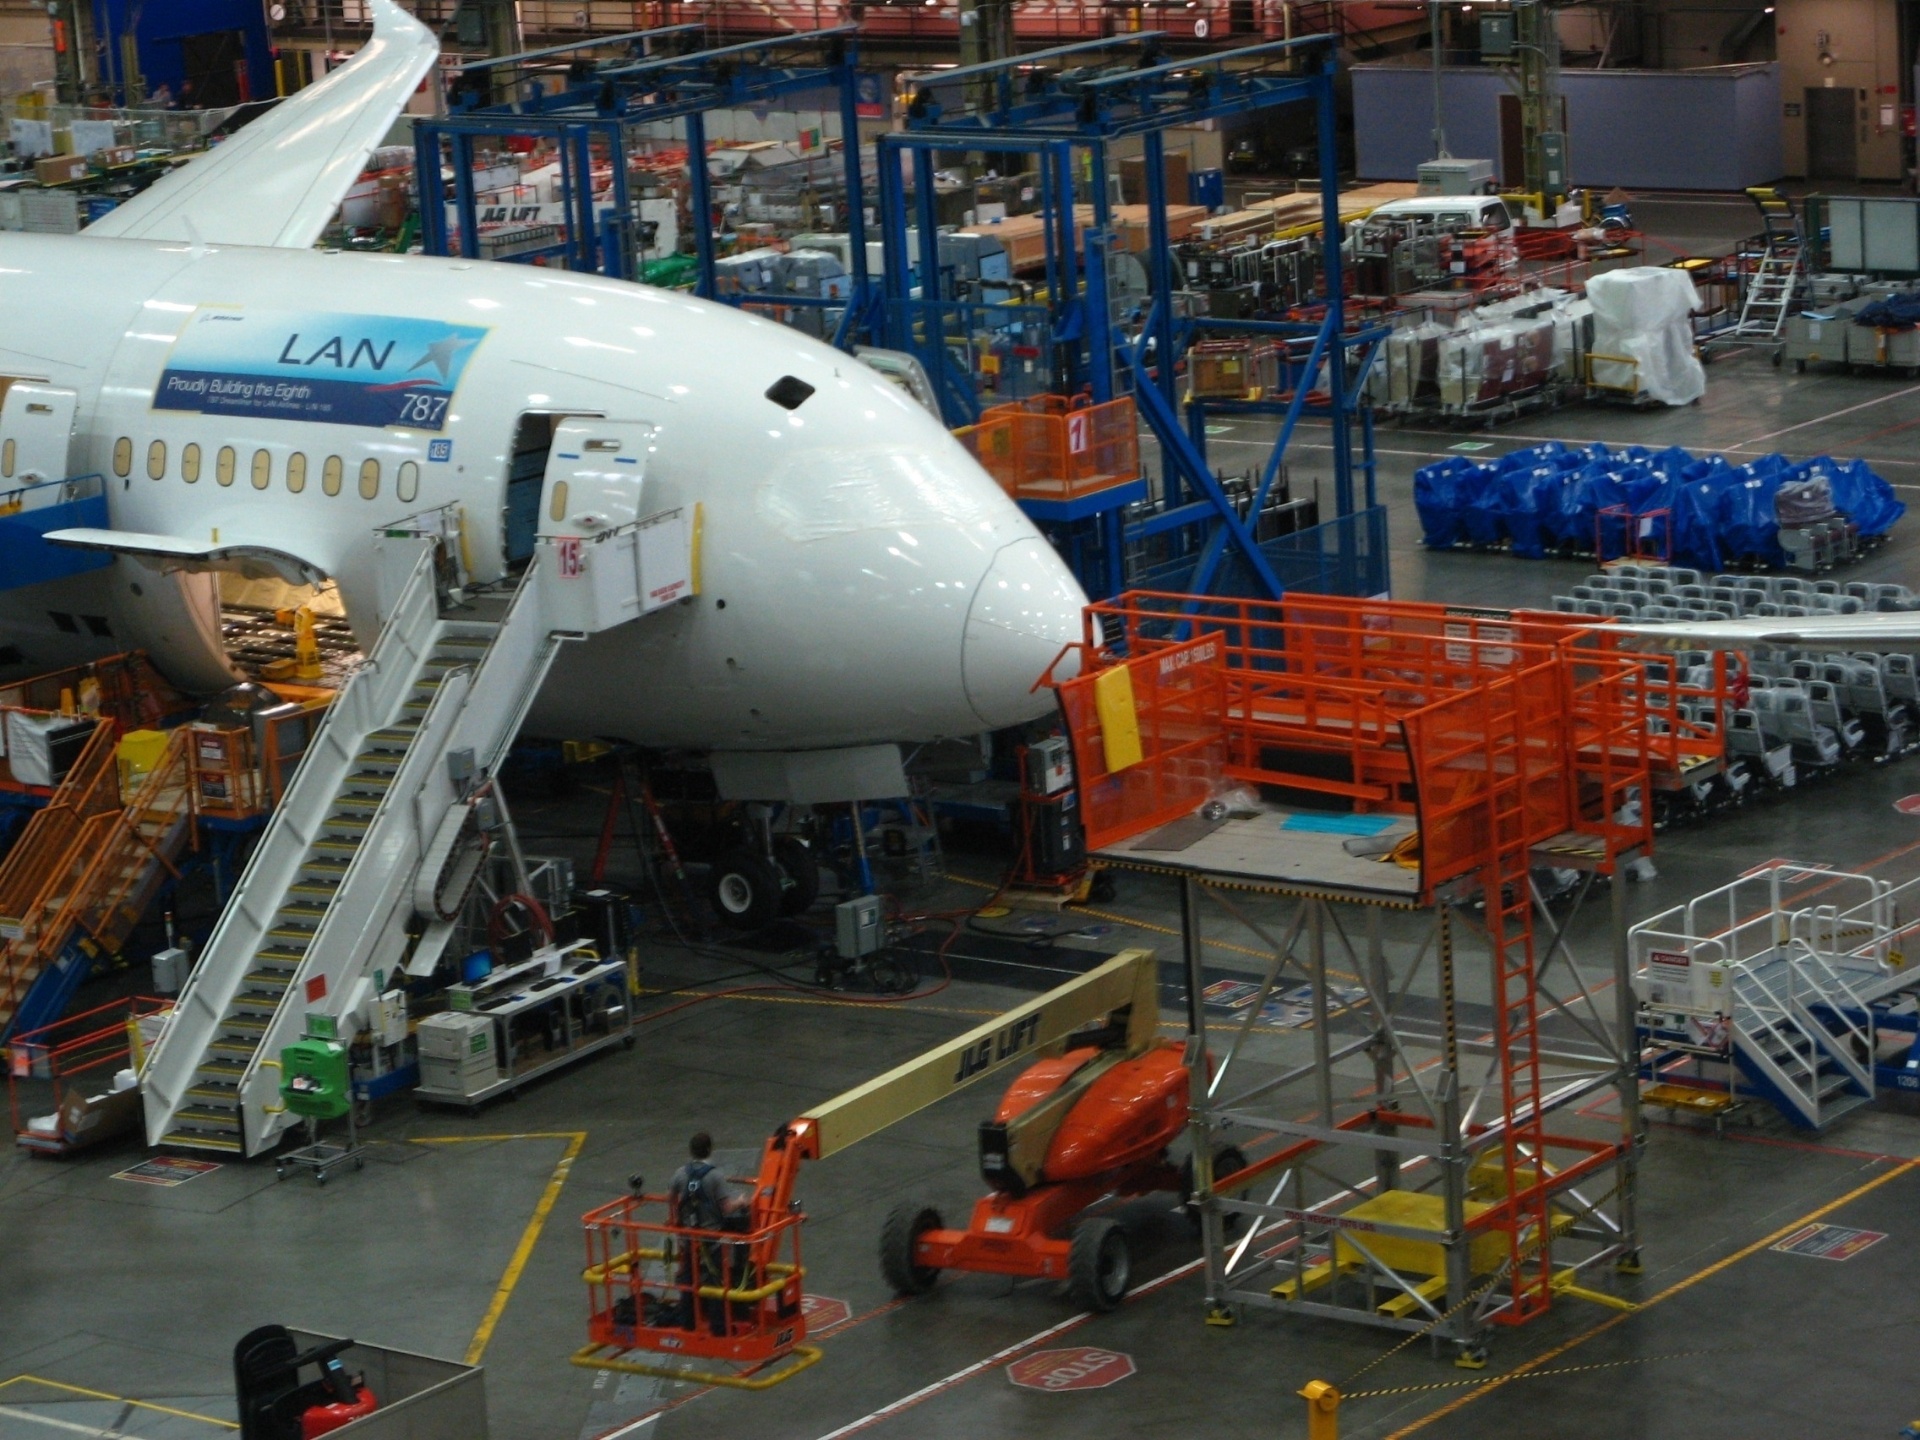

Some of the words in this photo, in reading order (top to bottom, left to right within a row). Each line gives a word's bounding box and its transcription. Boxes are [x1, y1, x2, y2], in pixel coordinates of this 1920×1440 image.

[481, 207, 507, 222] JLG
[508, 206, 541, 221] LIFT
[277, 333, 396, 371] LAN
[167, 376, 208, 395] Proudly
[209, 379, 252, 398] Building
[254, 382, 274, 396] the
[274, 383, 311, 400] Eighth
[400, 393, 448, 422] 787
[1070, 418, 1082, 451] 1
[430, 442, 447, 457] 185
[560, 542, 578, 575] 15
[1660, 954, 1687, 965] DANGER
[953, 1037, 992, 1084] JLG
[996, 1013, 1040, 1062] LIFT
[1285, 1210, 1305, 1221] TOOL
[1307, 1213, 1337, 1226] WEIGHT
[1040, 1352, 1118, 1387] STOP
